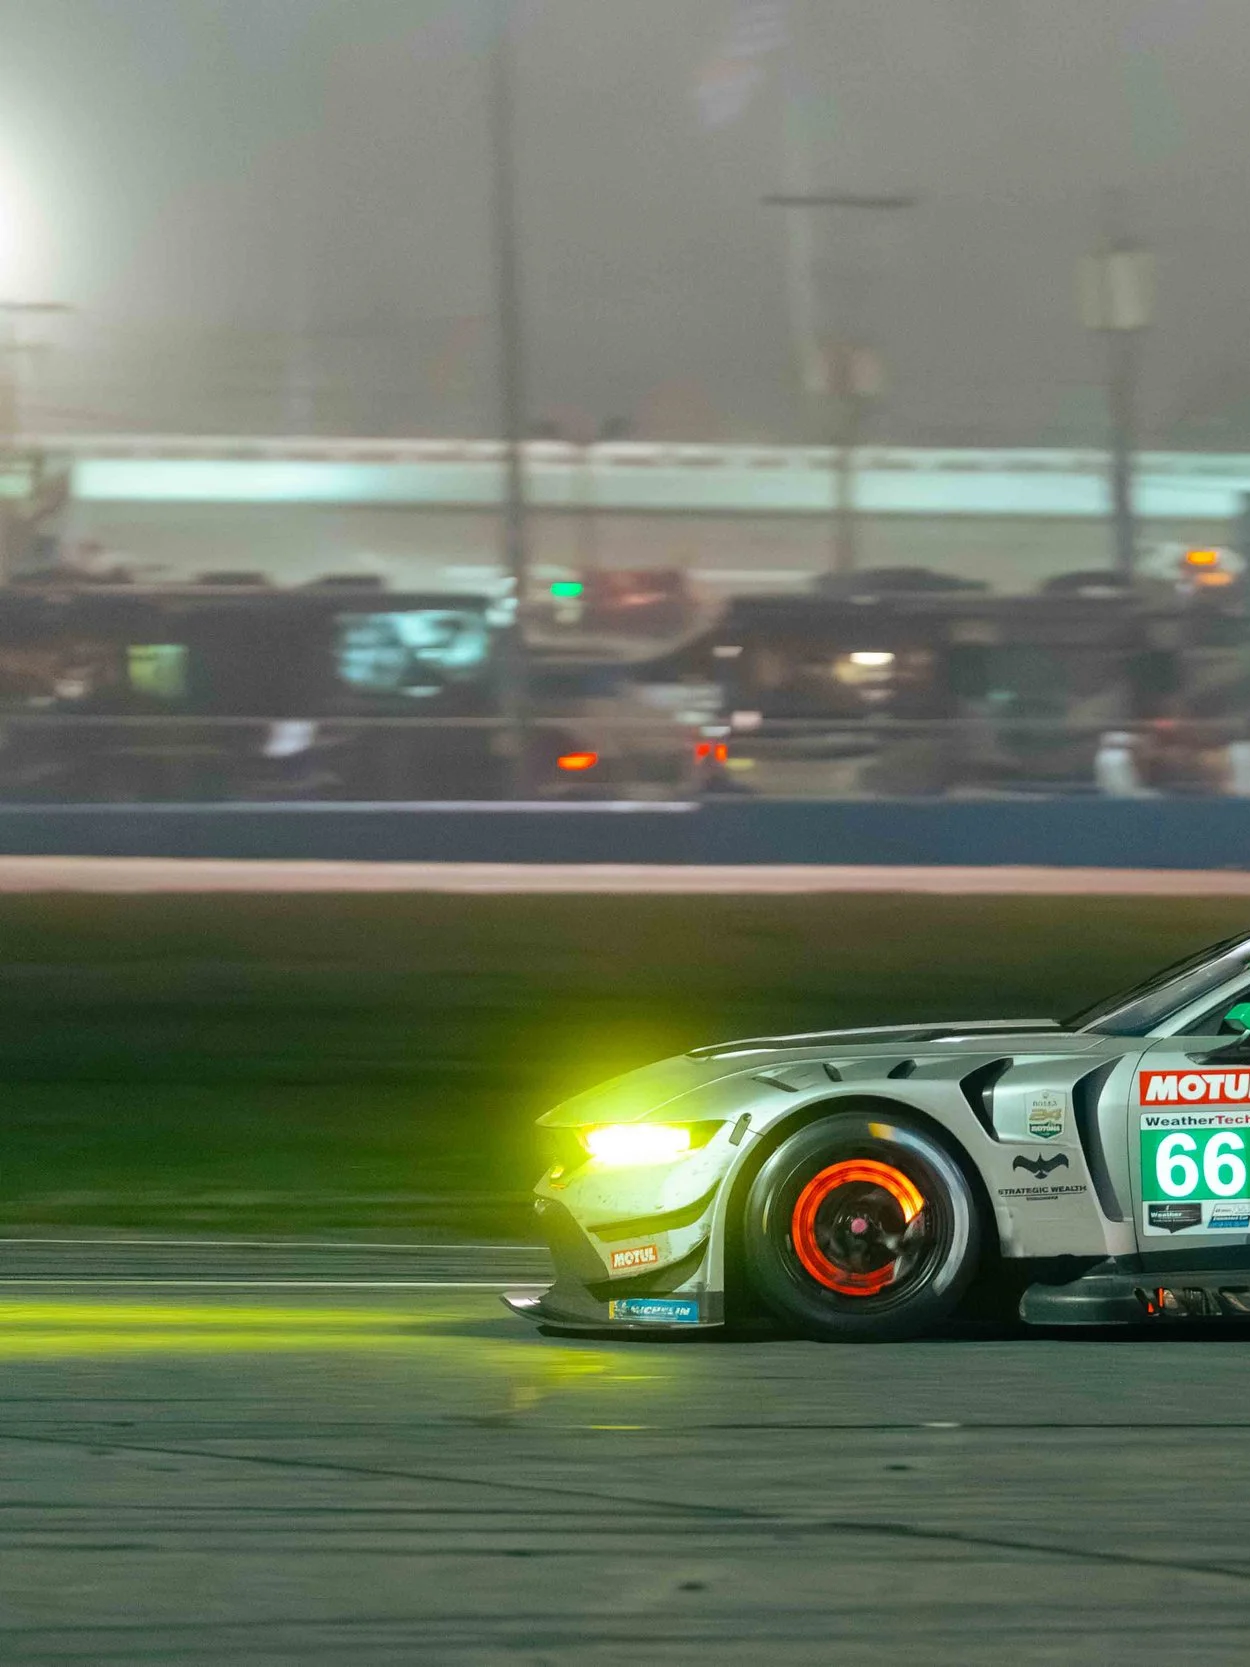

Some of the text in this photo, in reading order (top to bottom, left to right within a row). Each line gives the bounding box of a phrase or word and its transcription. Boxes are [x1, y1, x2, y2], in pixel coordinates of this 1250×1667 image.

[1155, 1131, 1247, 1198] 66
[998, 1185, 1088, 1195] STRATEGIC WEALTH
[613, 1247, 656, 1268] MOTUL
